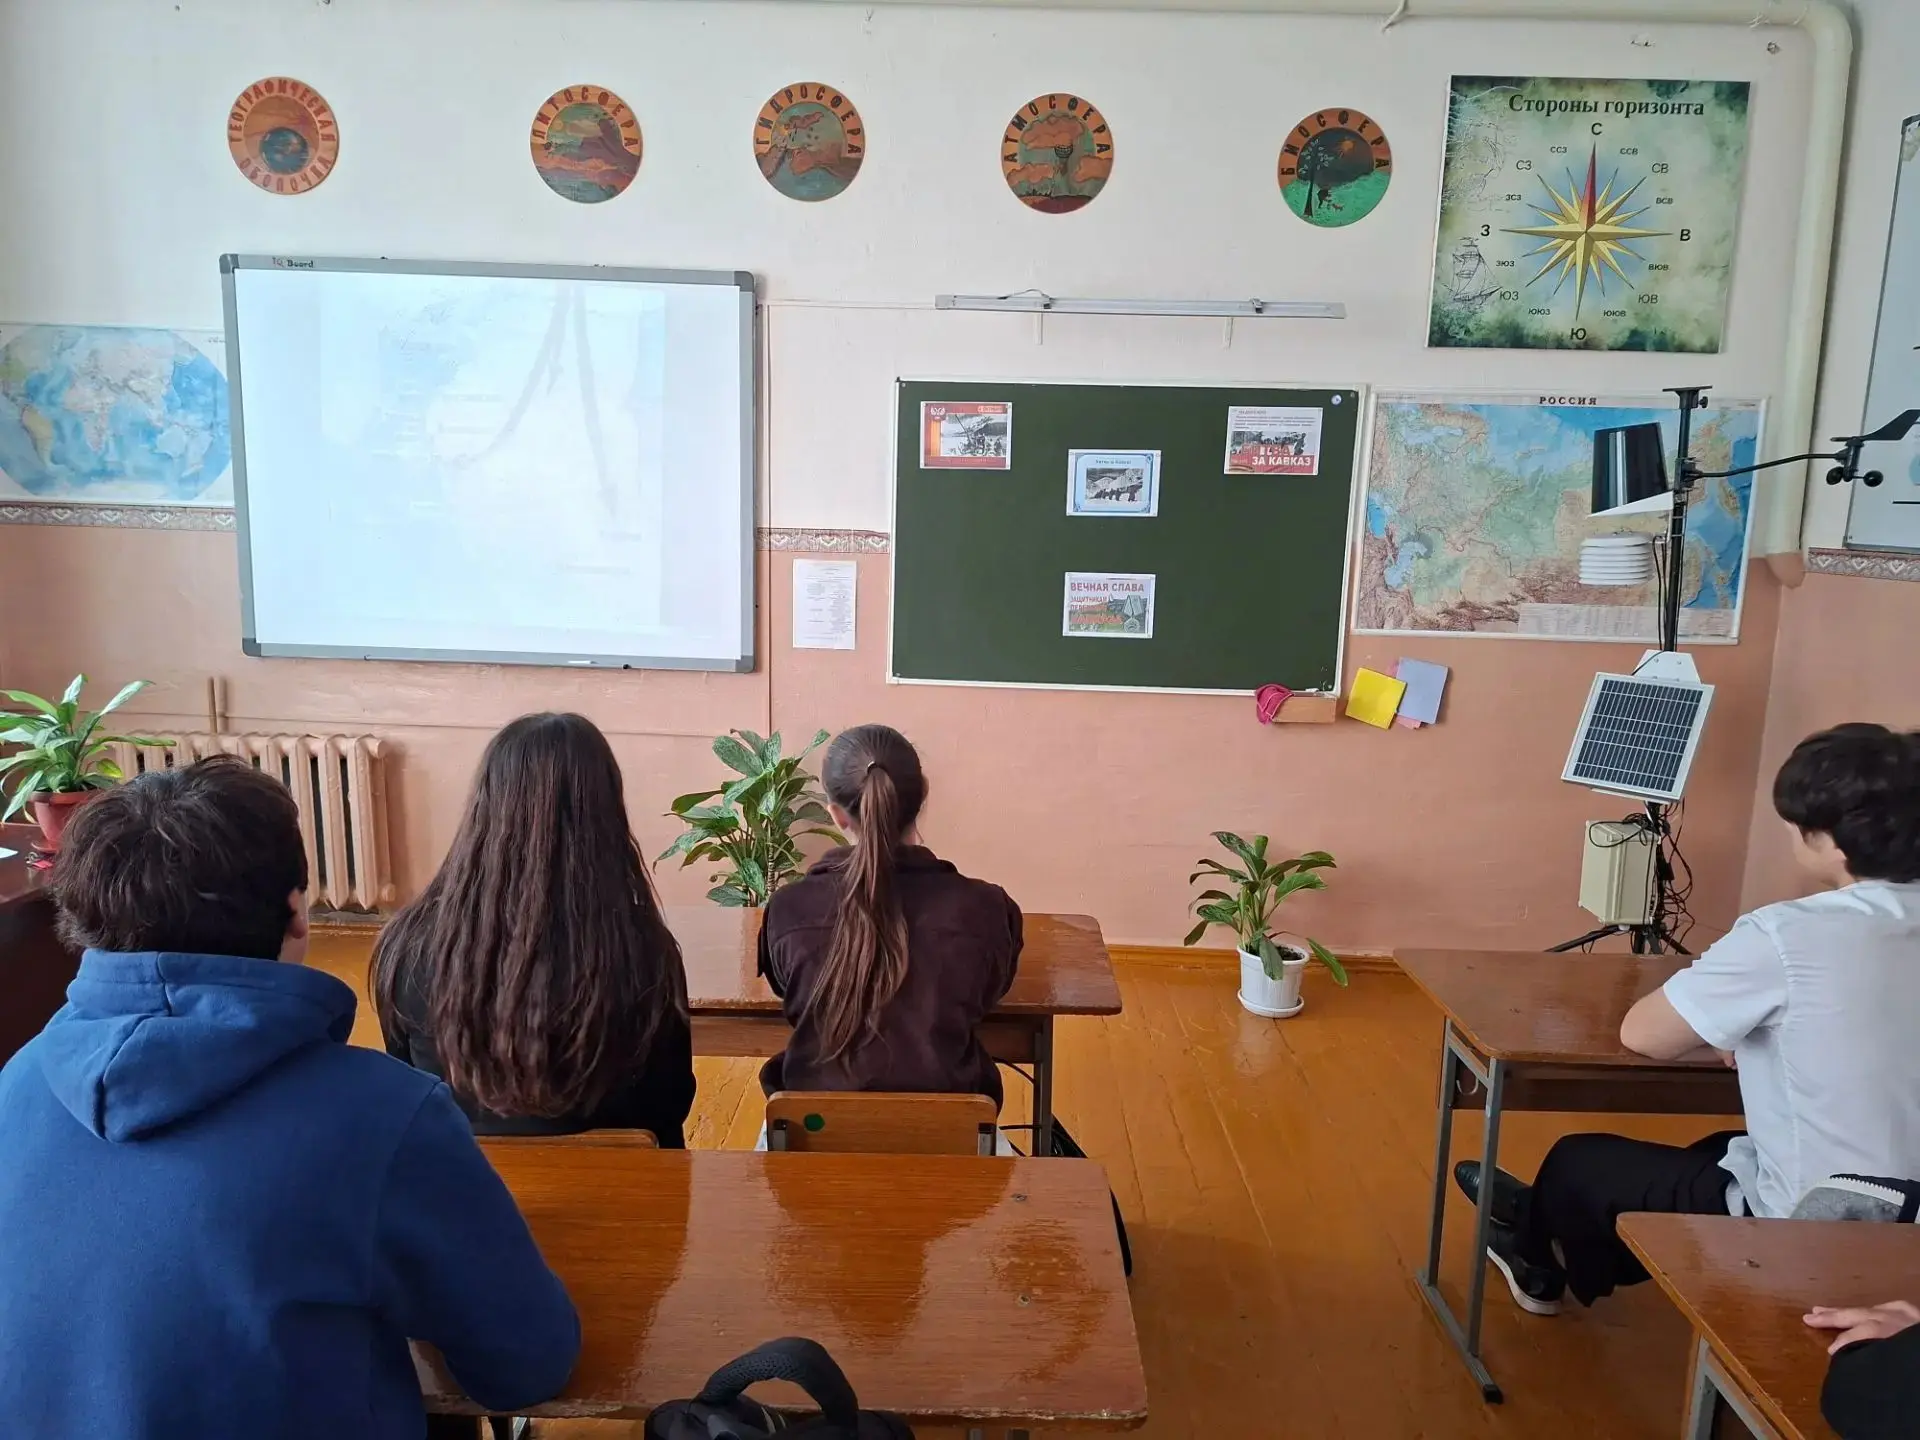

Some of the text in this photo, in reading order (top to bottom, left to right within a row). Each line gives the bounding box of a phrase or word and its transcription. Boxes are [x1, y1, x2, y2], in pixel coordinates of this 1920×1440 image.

[229, 79, 337, 142] ГЕОГРАФИЧЕСКАЯ
[1508, 94, 1705, 118] Стороны горизонта
[532, 86, 639, 147] ЛИТОСФЕРА
[756, 84, 862, 154] ГИДРОСФЕРА
[1004, 95, 1111, 162] АТМОСФЕРА
[1591, 123, 1603, 136] С
[1281, 110, 1390, 175] БИОСФЕРА
[1550, 146, 1568, 154] ССЗ
[1516, 160, 1532, 171] СЗ
[1651, 163, 1669, 174] СВ
[240, 155, 332, 192] ОБОЛОЧКА
[1655, 197, 1674, 205] ВСВ
[1480, 224, 1491, 237] З
[1679, 229, 1691, 242] В
[1648, 263, 1669, 271] ВЮВ
[1499, 290, 1519, 301] ЮЗ
[1637, 293, 1658, 304] ЮВ
[1570, 328, 1587, 340] Ю
[1539, 396, 1597, 406] РОССИЯ
[1252, 456, 1266, 466] ЗА
[1268, 456, 1312, 466] КАВКАЗ
[1070, 582, 1145, 592] ВЕЧНАЯ СЛАВА
